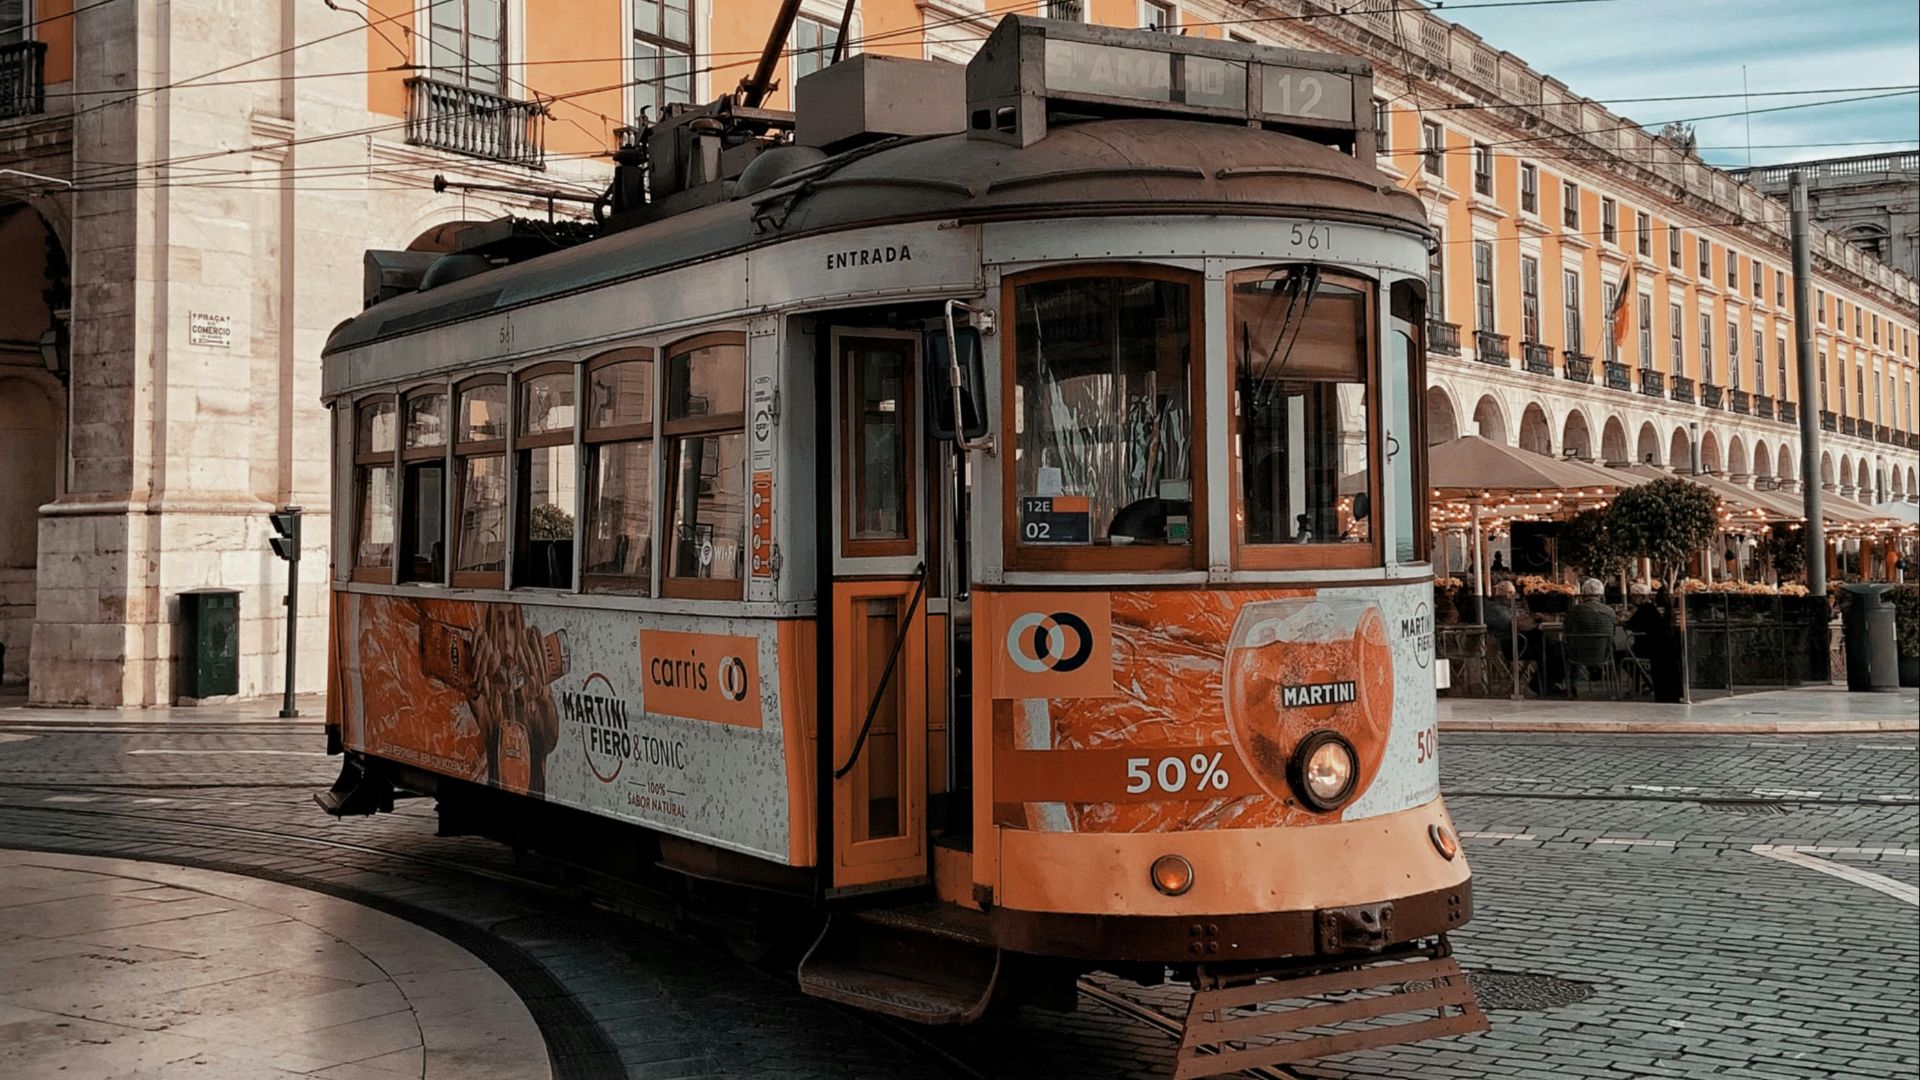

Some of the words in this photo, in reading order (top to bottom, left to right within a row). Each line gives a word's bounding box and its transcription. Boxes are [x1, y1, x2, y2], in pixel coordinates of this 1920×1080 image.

[1279, 74, 1322, 118] 12
[1291, 223, 1330, 250] 561
[827, 245, 912, 270] ENTRADA
[198, 313, 226, 323] PRAÇA
[500, 325, 514, 343] 561
[1027, 501, 1050, 512] 12E
[1026, 522, 1050, 539] 02
[651, 648, 708, 692] carris
[1284, 683, 1355, 706] MARTINI
[562, 692, 628, 730] MARTINI
[591, 727, 631, 759] FIERO
[1126, 752, 1229, 794] 50%
[647, 781, 665, 796] 100%
[627, 792, 650, 809] SABOR
[651, 799, 686, 818] NATURAL
